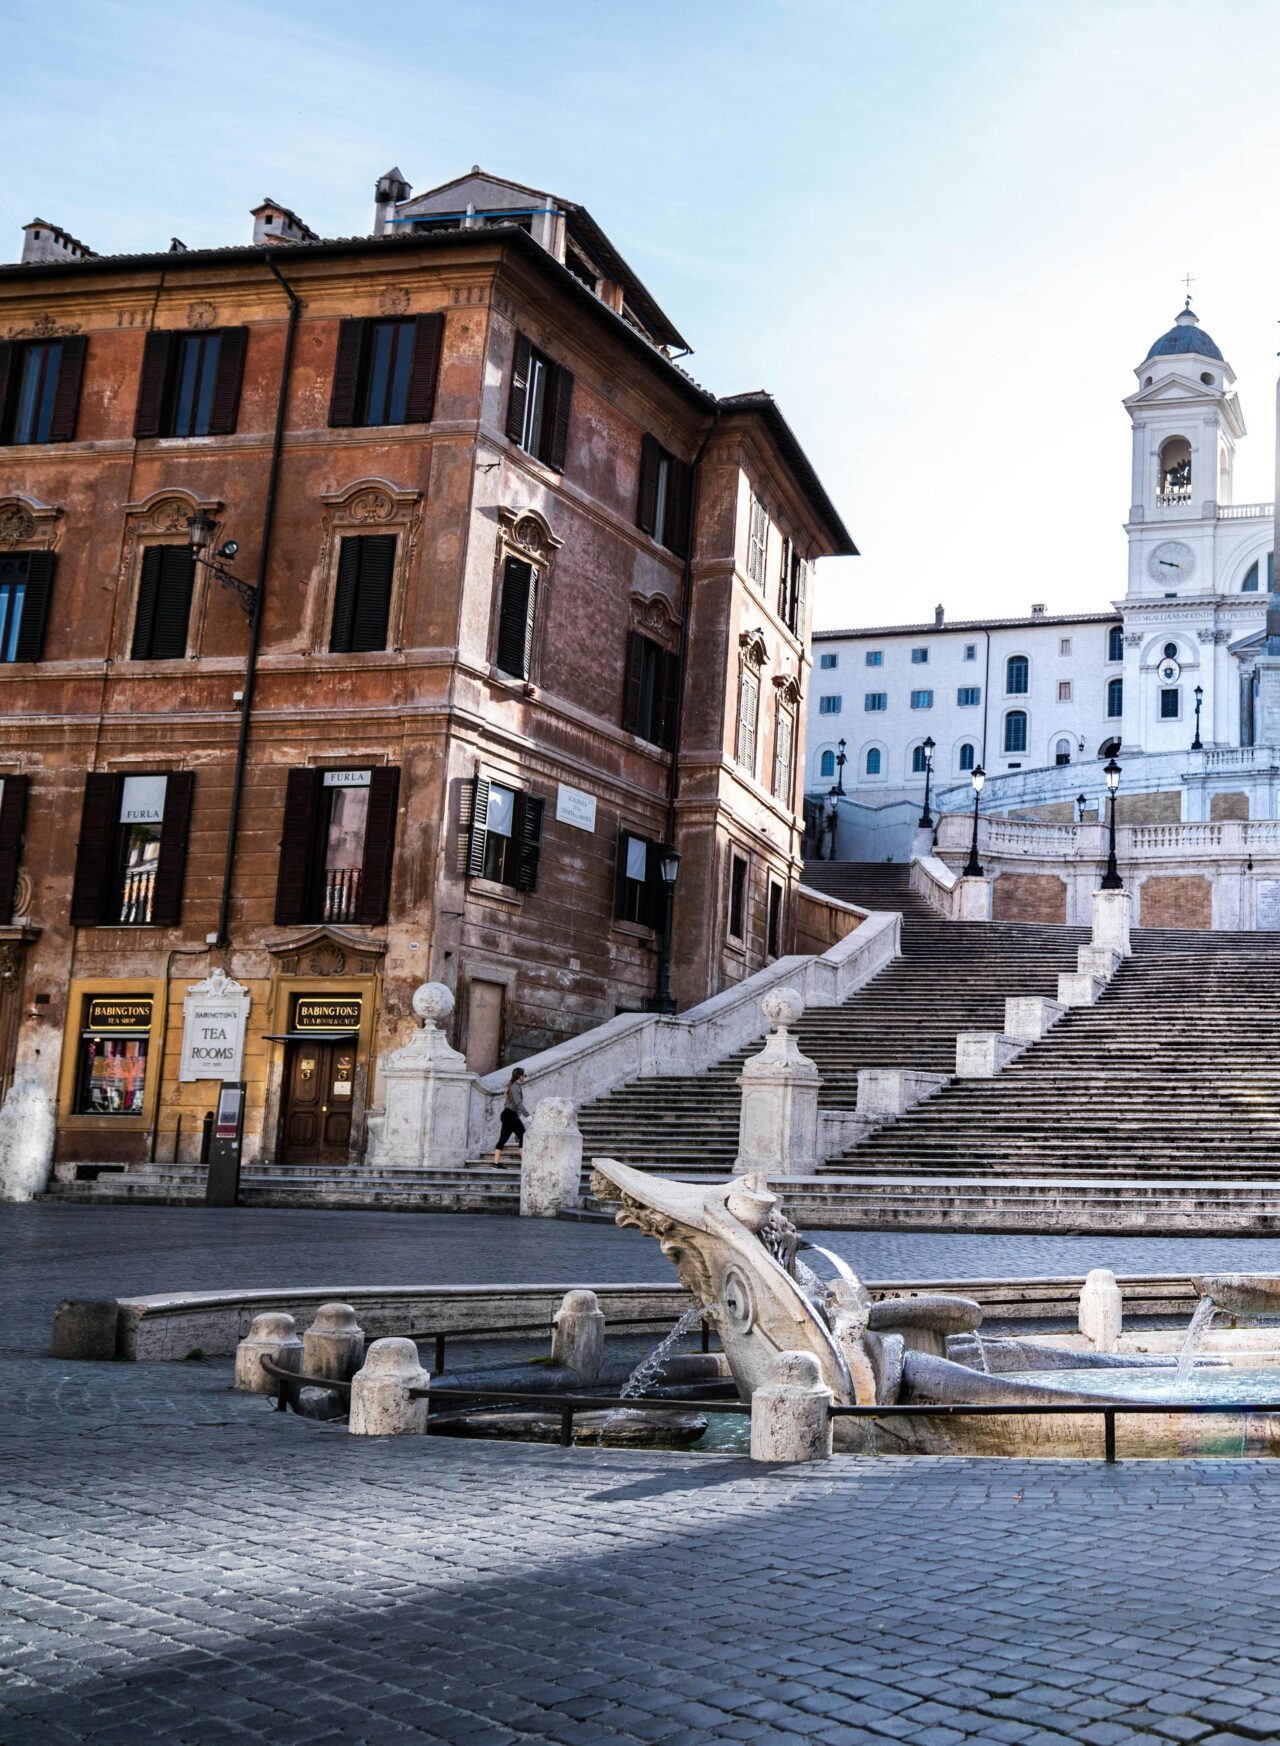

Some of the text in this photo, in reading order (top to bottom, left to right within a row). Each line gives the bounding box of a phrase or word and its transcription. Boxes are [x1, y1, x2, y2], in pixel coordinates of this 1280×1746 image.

[330, 773, 364, 781] FURLA
[127, 810, 160, 819] FURLA
[95, 1007, 150, 1016] BABINGTONS
[301, 1006, 358, 1016] BABINGTONS
[201, 1027, 228, 1040] TEA
[191, 1047, 234, 1060] ROOMS
